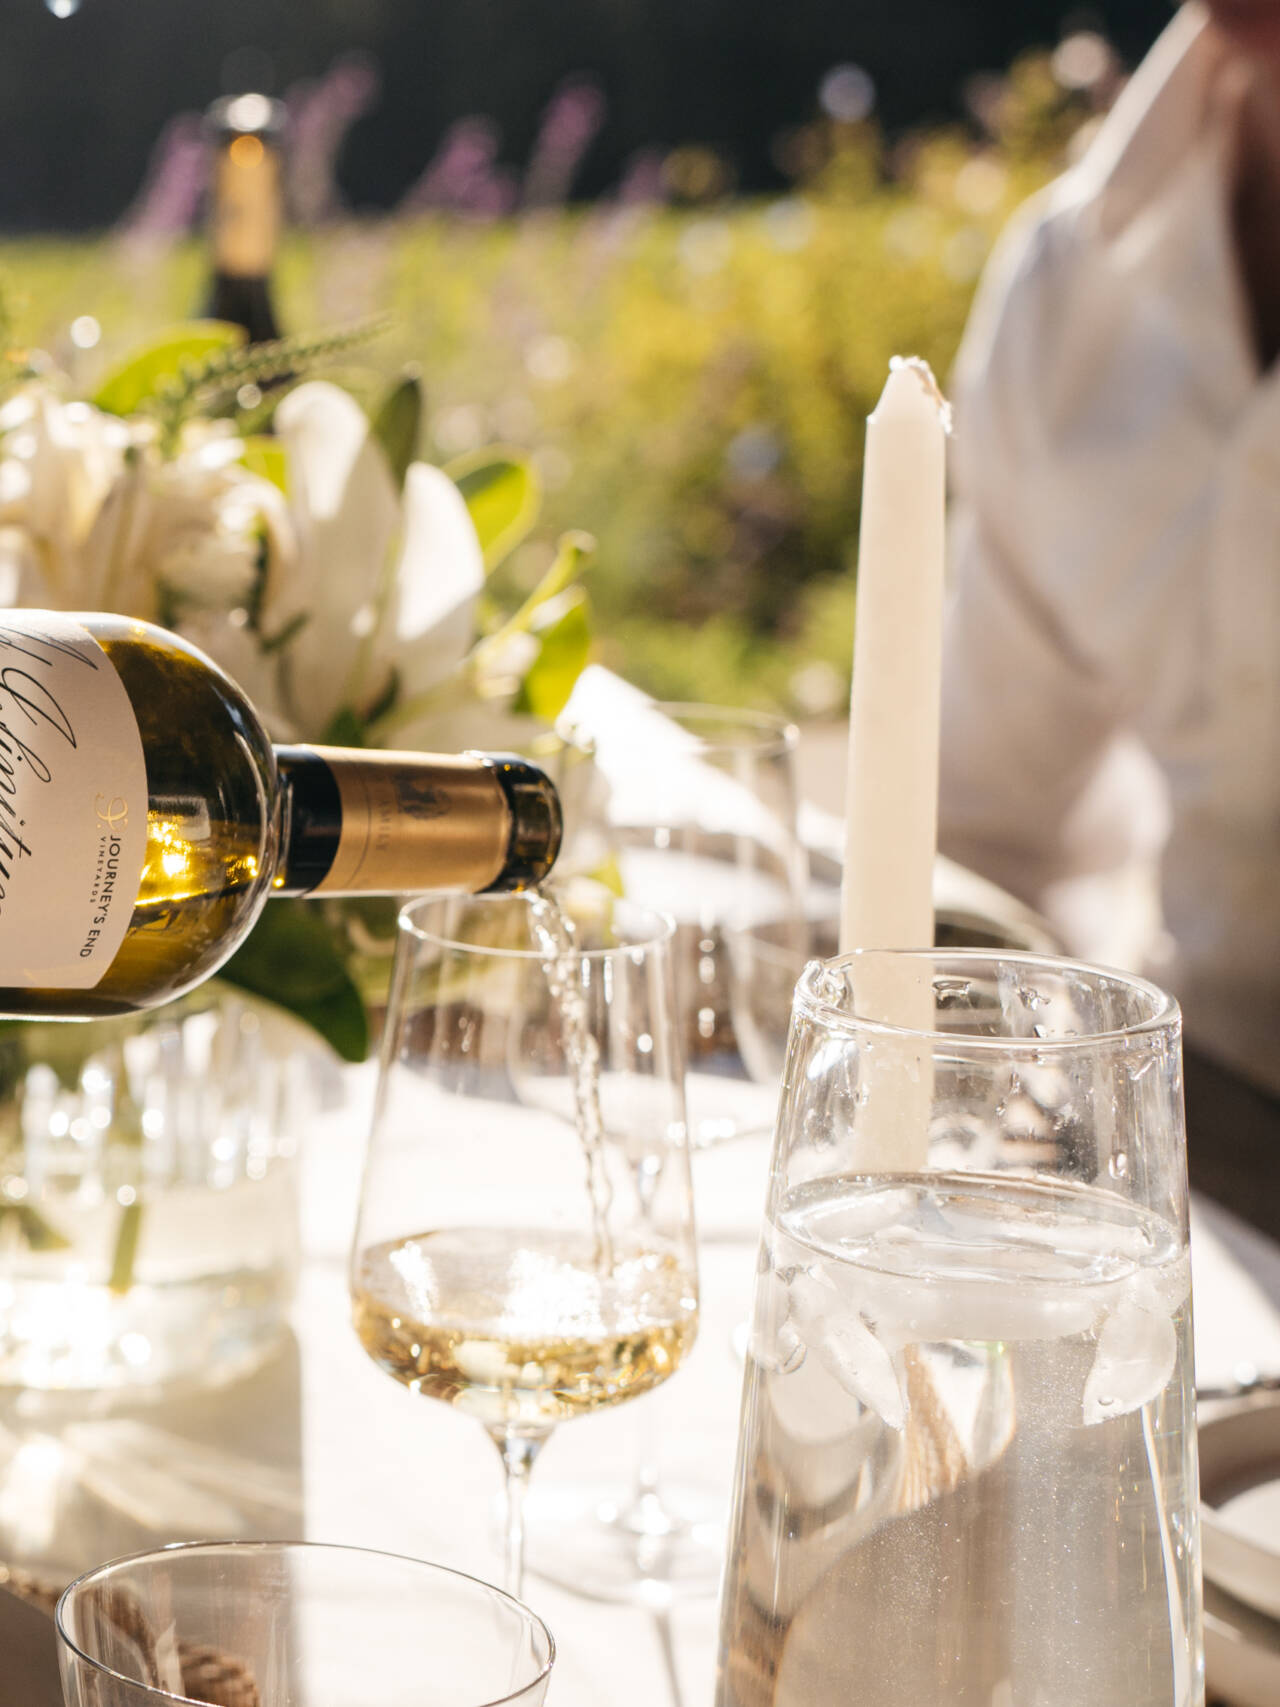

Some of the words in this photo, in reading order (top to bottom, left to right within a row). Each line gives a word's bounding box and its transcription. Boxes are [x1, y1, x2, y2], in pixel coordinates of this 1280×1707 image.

[89, 836, 107, 903] VINEYARDS
[93, 834, 122, 925] JOURNEY'S
[80, 928, 101, 958] END
